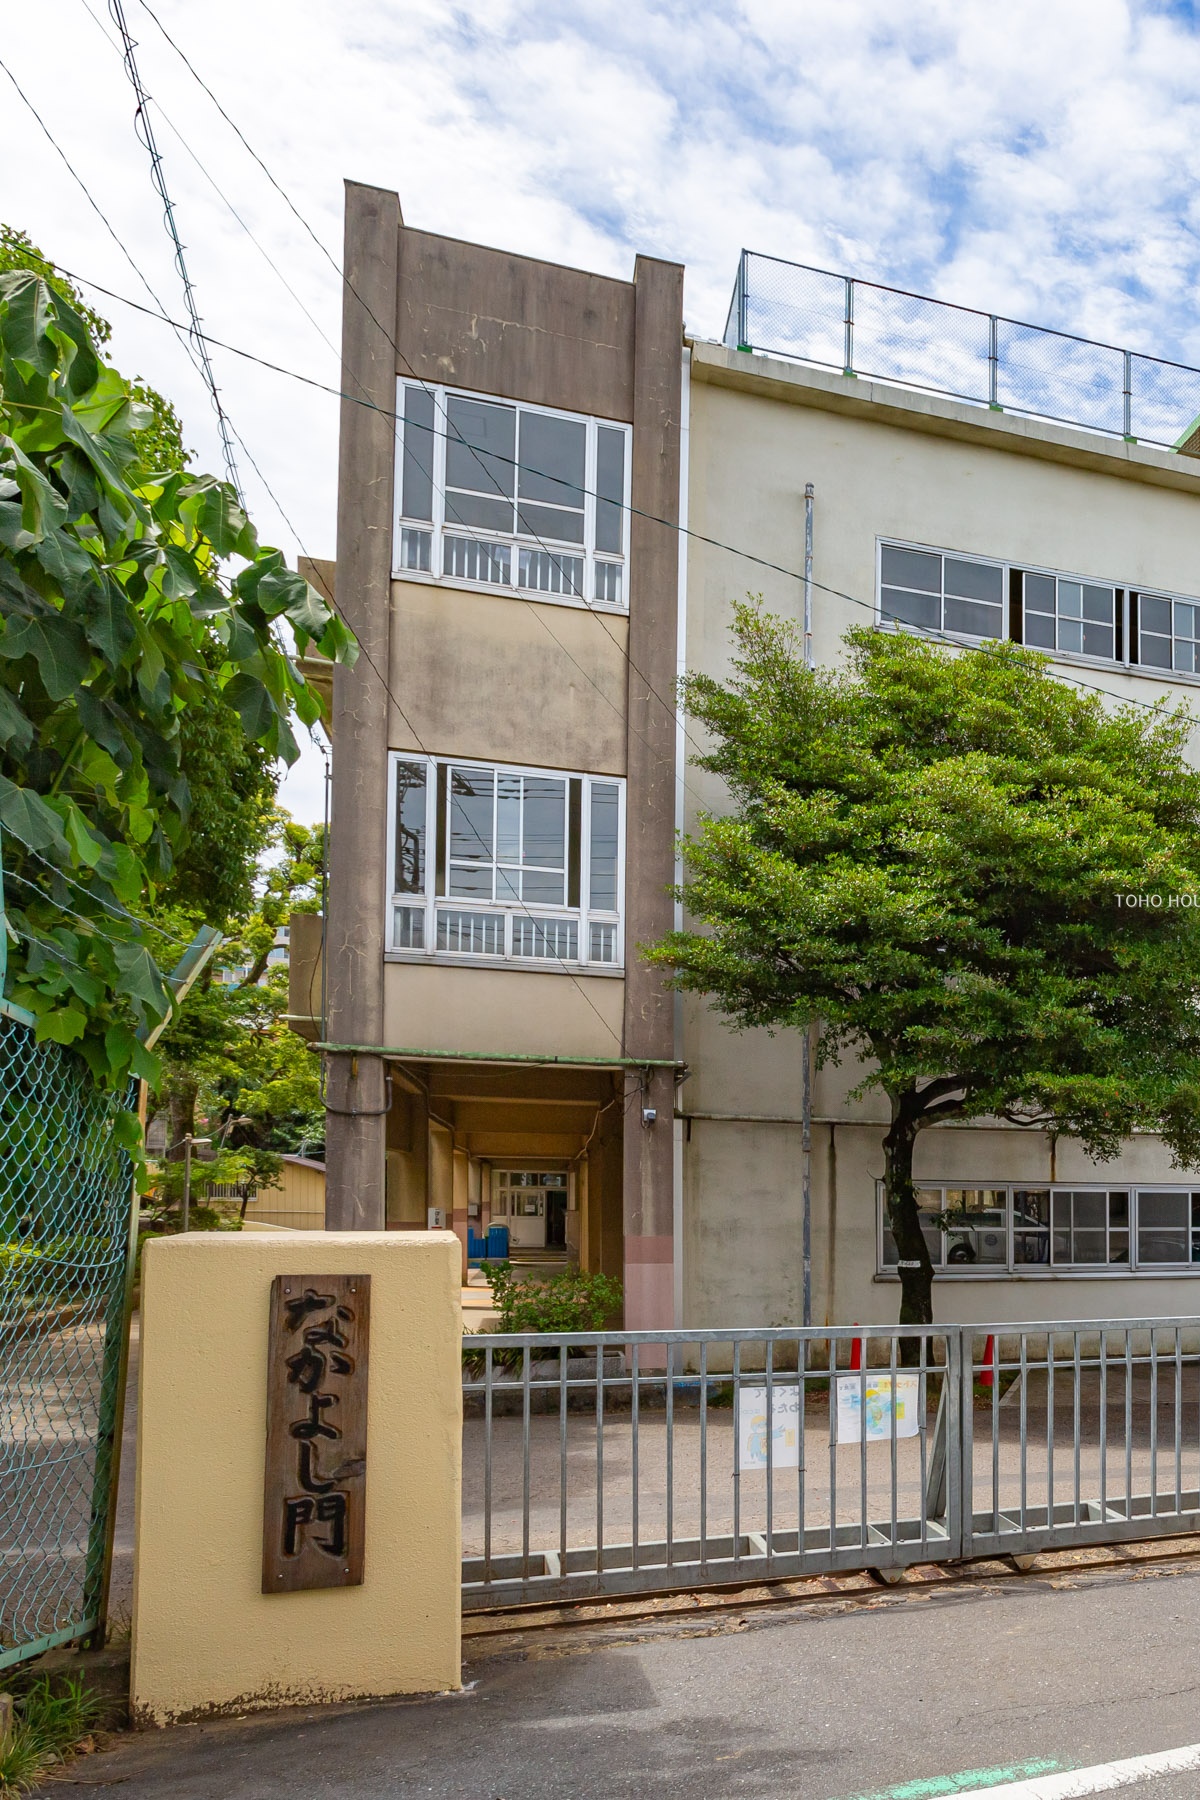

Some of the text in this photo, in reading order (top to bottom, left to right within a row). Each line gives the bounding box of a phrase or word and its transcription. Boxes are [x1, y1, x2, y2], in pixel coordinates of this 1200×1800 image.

[281, 1288, 356, 1560] なかよし門
